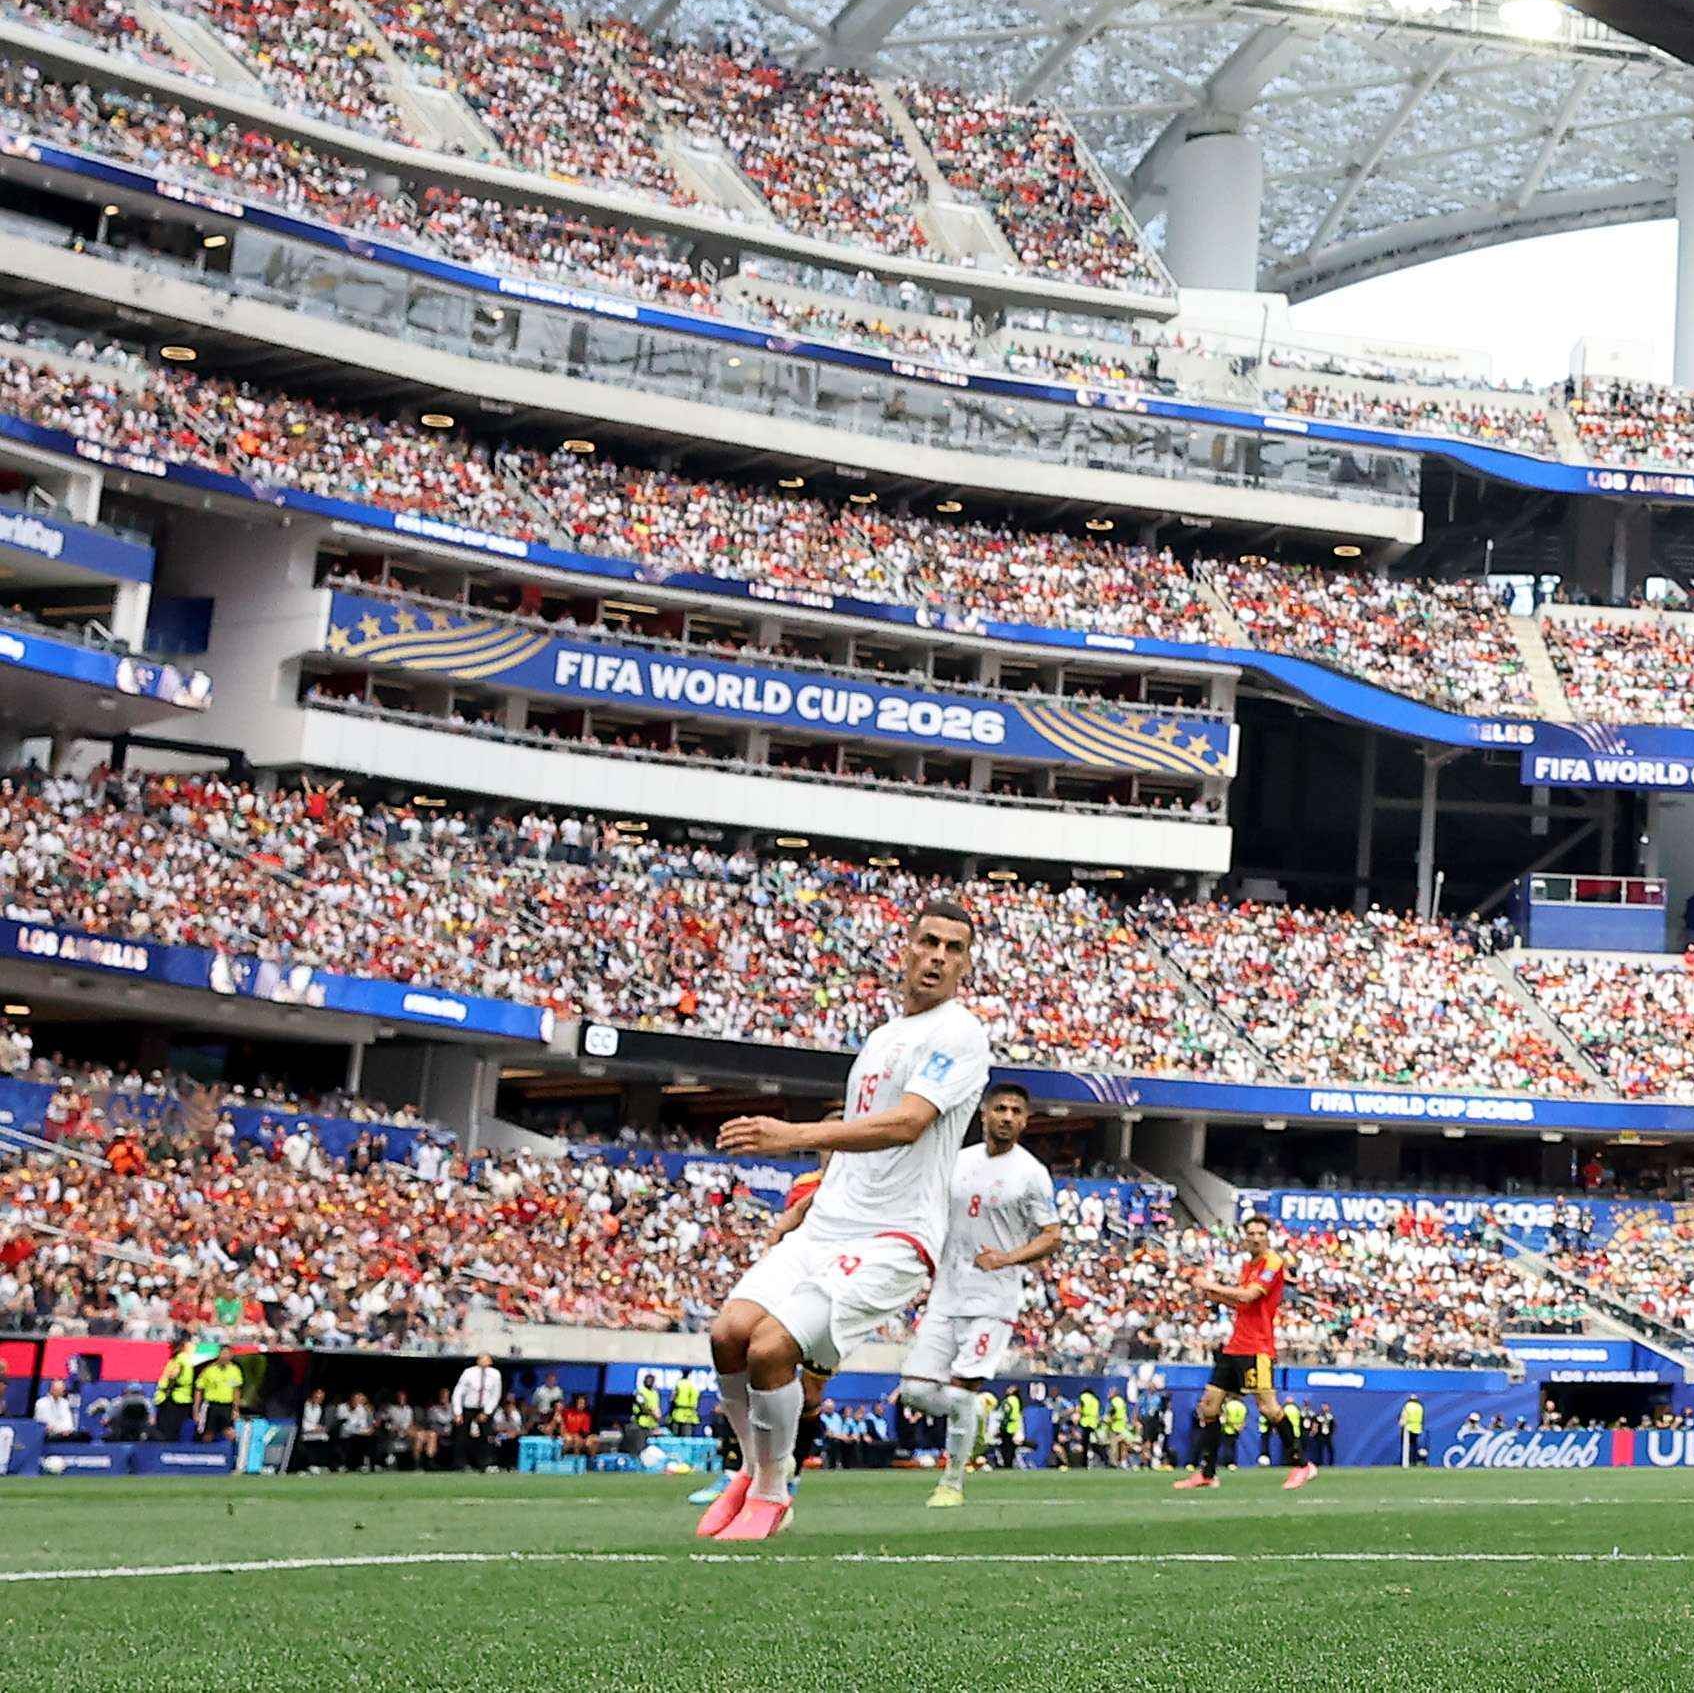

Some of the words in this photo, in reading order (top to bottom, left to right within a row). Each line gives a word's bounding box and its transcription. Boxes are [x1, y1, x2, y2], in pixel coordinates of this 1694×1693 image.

[1587, 471, 1629, 493] LOS
[554, 649, 643, 697] FIFA
[648, 662, 793, 715] WORLD
[797, 685, 873, 726] CUP
[875, 697, 1007, 746] 2026
[1534, 757, 1590, 784] FIFA
[1594, 760, 1691, 786] WORLD
[17, 926, 60, 957] LOS
[1310, 1092, 1355, 1113] FIFA
[1354, 1093, 1426, 1117] WORLD
[1425, 1097, 1467, 1118] CUP
[968, 1193, 982, 1218] 8
[1281, 1195, 1339, 1221] FIFA
[975, 1333, 990, 1357] 8
[1444, 1429, 1604, 1469] Michelob
